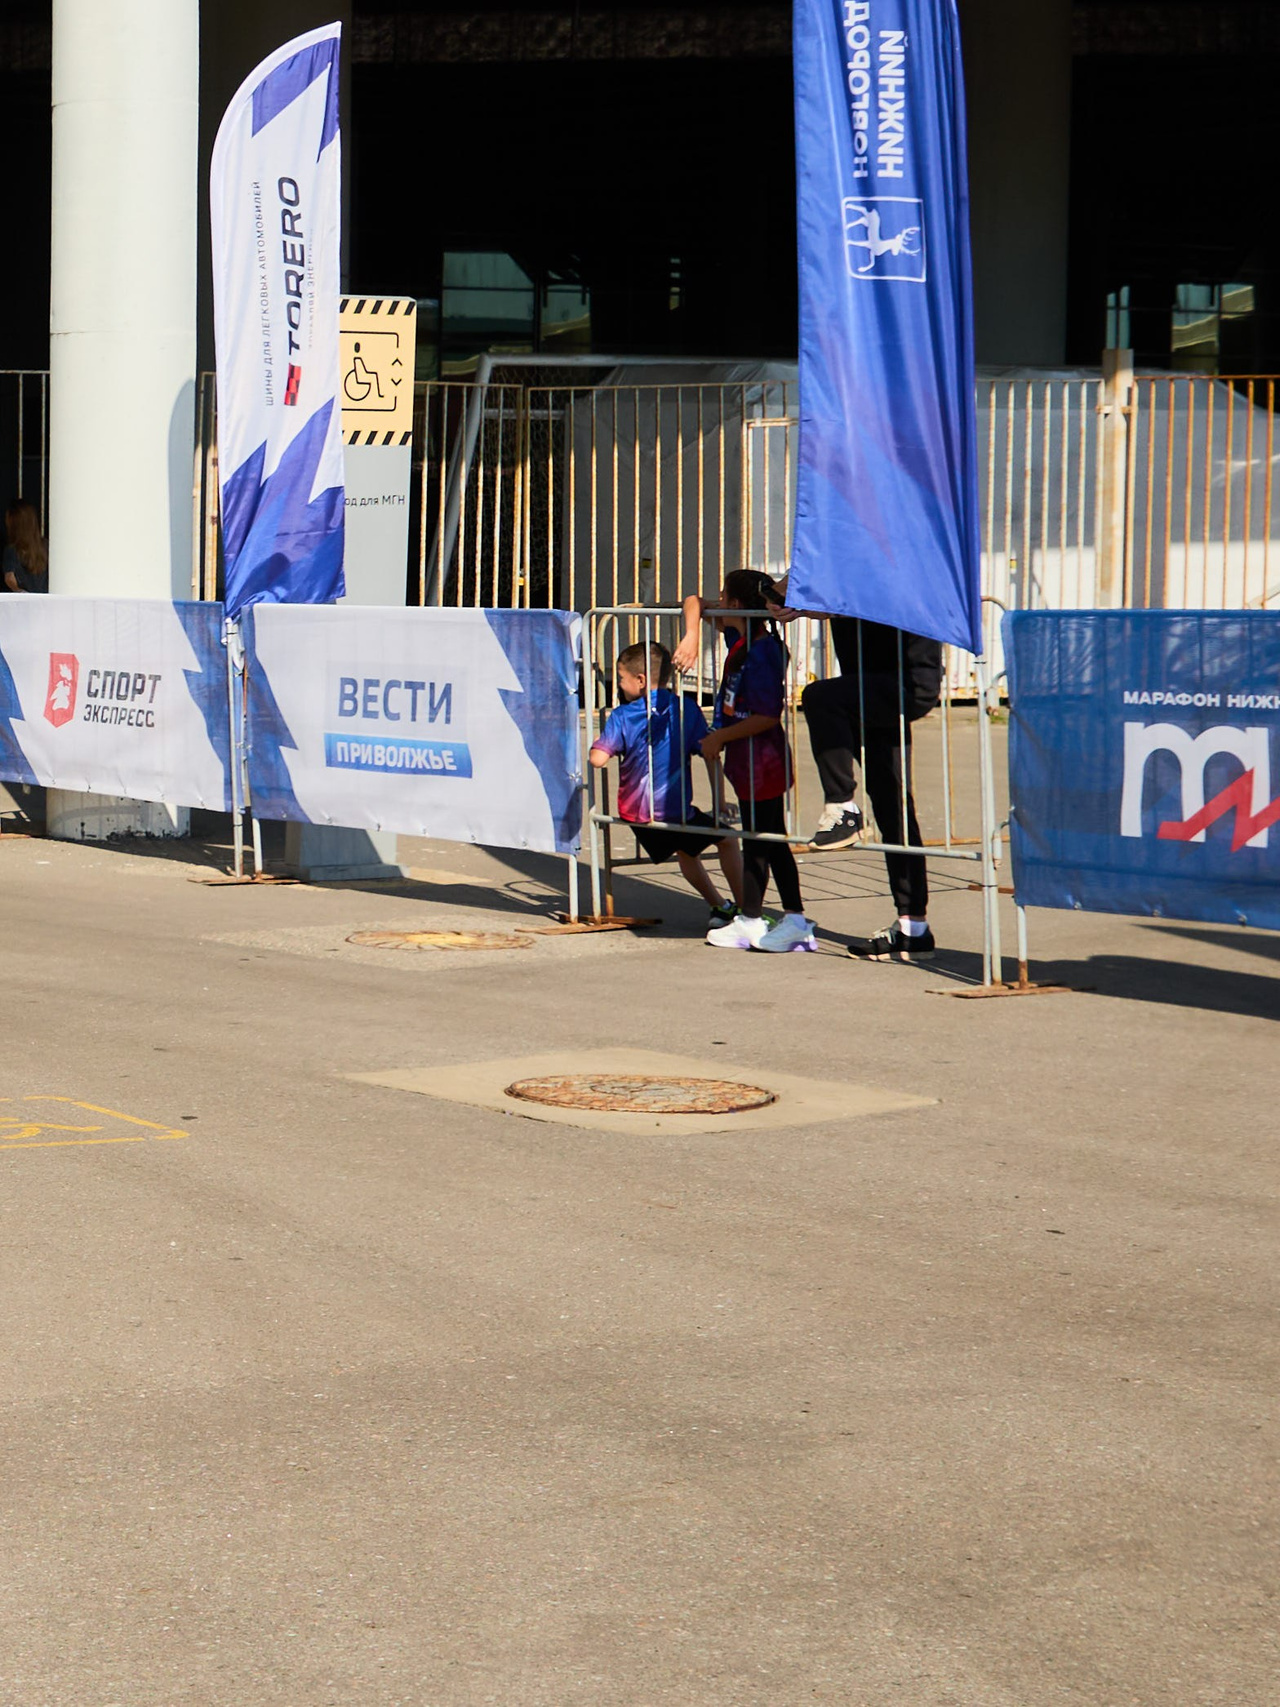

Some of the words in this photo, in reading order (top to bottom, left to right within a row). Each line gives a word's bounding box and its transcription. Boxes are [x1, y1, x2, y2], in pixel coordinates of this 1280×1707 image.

[252, 180, 266, 270] АВТОМОБИЛЕЙ
[277, 176, 306, 355] TORERO
[257, 274, 271, 337] ЛЕГКОВЫХ
[262, 338, 273, 365] ДЛЯ
[342, 497, 357, 506] од
[359, 497, 379, 506] для
[381, 495, 405, 505] МГН
[86, 669, 161, 703] СПОРТ
[338, 677, 452, 724] ВЕСТИ
[1123, 691, 1220, 708] МАРАФОН
[83, 704, 155, 728] ЭКСПРЕСС
[336, 741, 458, 771] ПРИВОЛЖЬЕ
